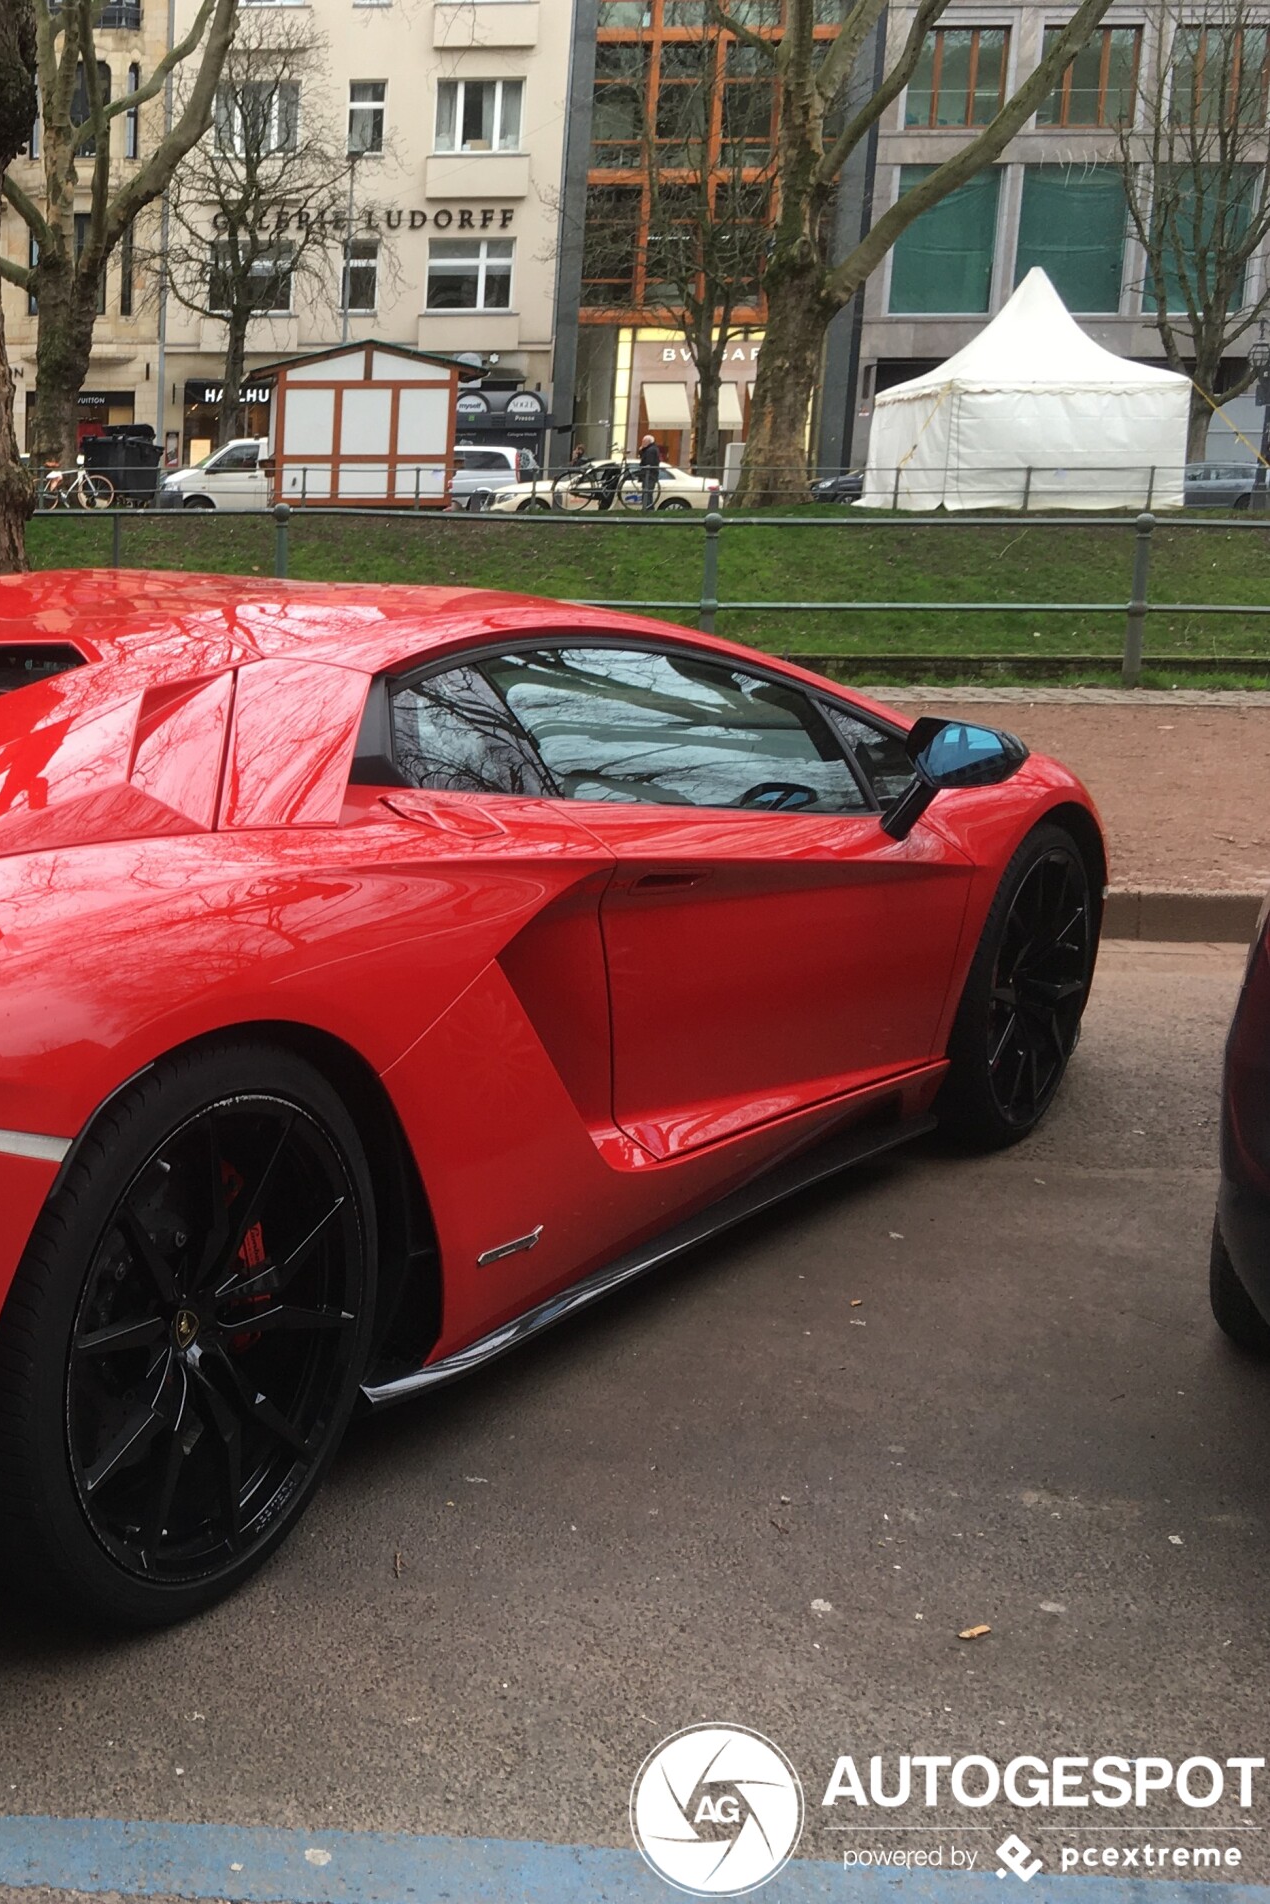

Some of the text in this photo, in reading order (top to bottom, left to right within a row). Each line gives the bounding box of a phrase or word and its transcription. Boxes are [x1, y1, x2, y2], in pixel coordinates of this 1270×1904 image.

[213, 209, 515, 231] GLERIE LUDORFF
[204, 388, 270, 403] HALHU
[458, 402, 482, 410] myself
[514, 414, 535, 422] Presse
